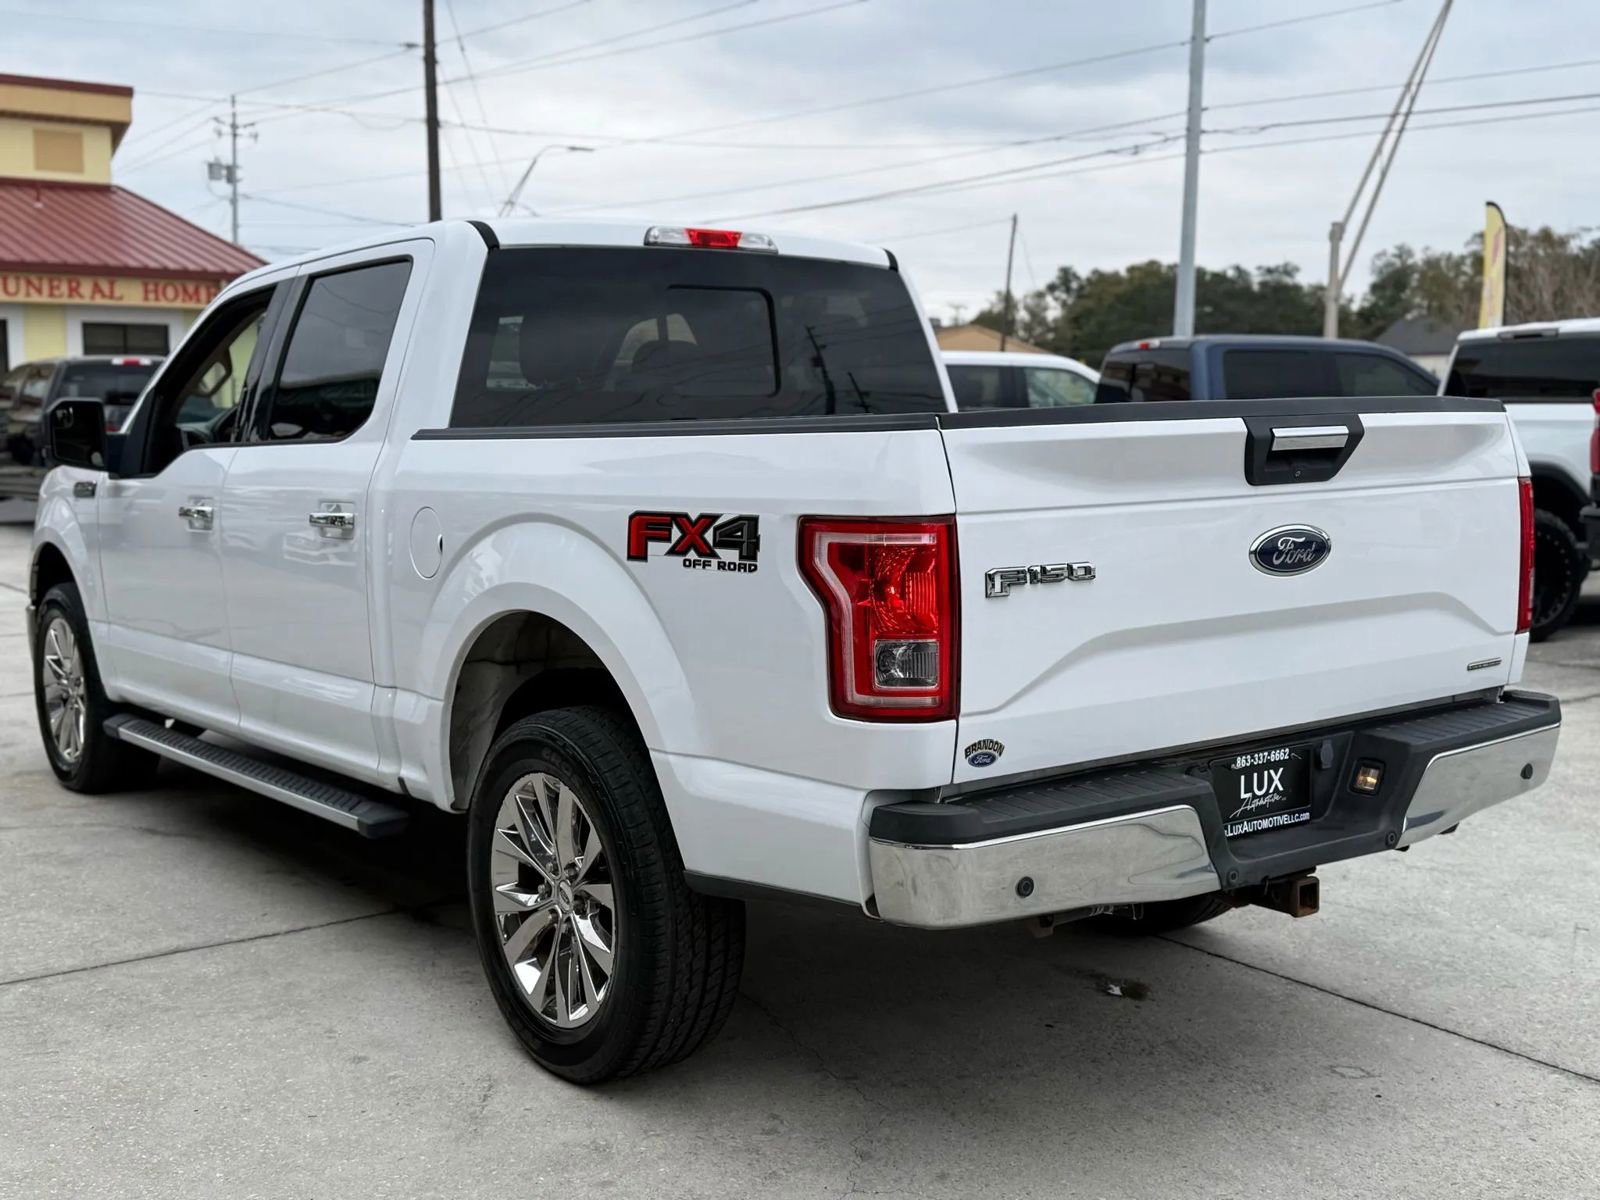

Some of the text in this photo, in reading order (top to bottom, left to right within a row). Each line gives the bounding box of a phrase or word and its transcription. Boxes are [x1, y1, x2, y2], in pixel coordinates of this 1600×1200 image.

[627, 510, 760, 562] FX4
[682, 558, 758, 573] OFF ROAD
[985, 561, 1096, 598] F150
[964, 739, 1005, 760] BRANDON
[1236, 748, 1290, 768] 863-337-6662
[1240, 767, 1284, 799] LUX
